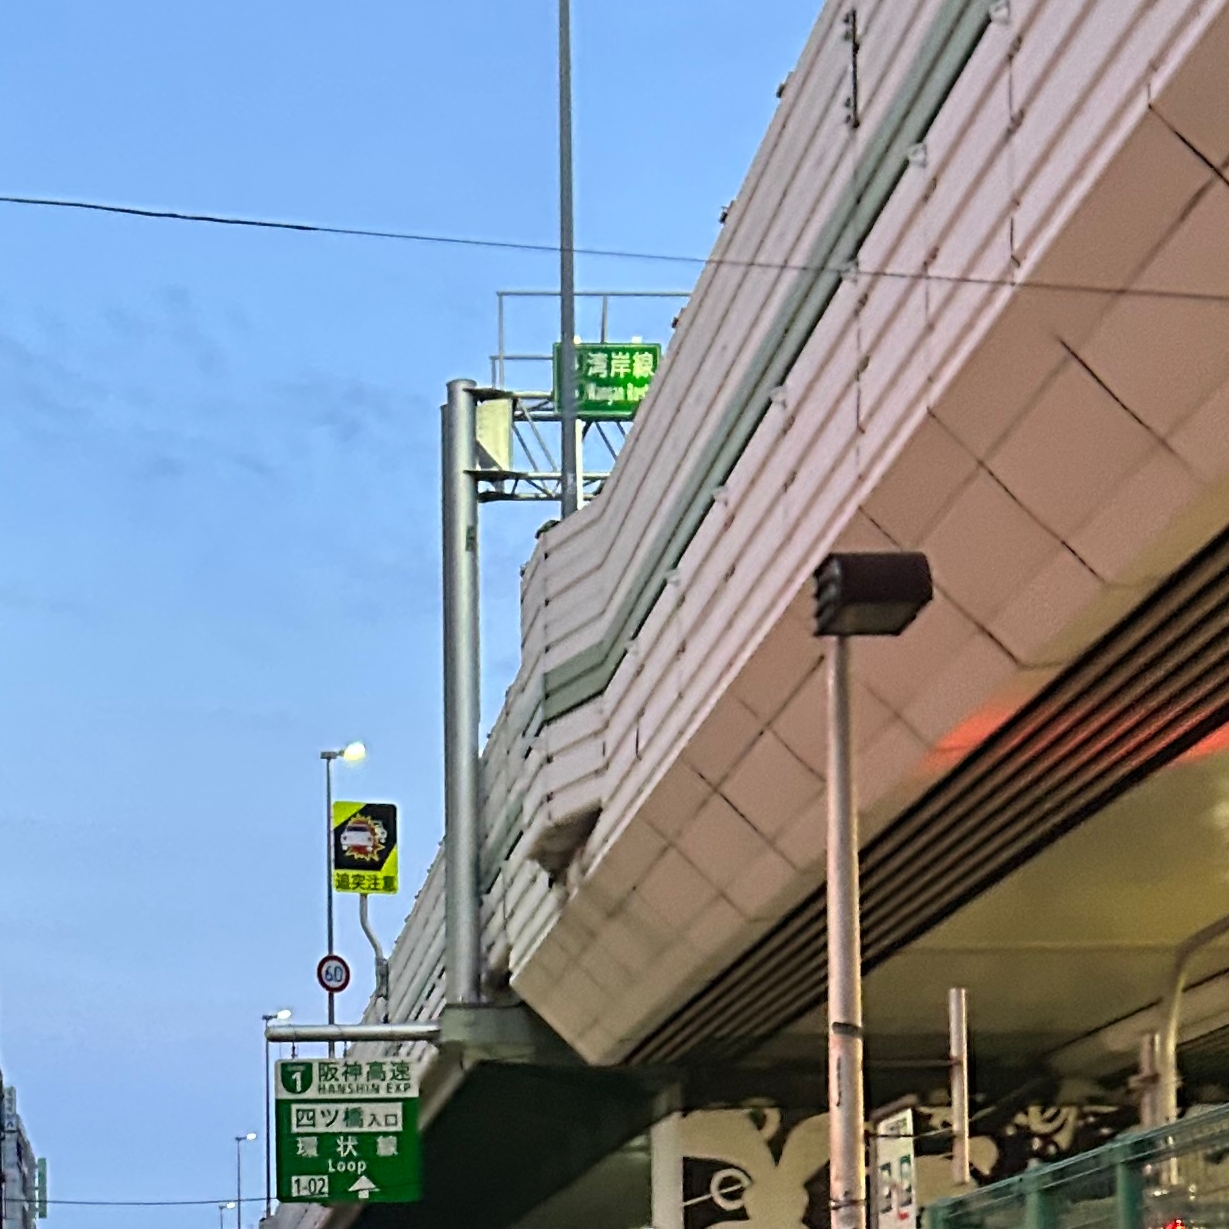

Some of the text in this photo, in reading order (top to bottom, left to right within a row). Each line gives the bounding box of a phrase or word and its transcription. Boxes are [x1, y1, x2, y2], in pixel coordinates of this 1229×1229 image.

[324, 966, 344, 983] 60
[318, 1061, 412, 1082] 阪神高速
[291, 1071, 303, 1093] 1
[318, 1082, 412, 1095] HANSHIN EXP
[328, 1159, 367, 1175] Loop
[294, 1177, 327, 1196] 1-02
